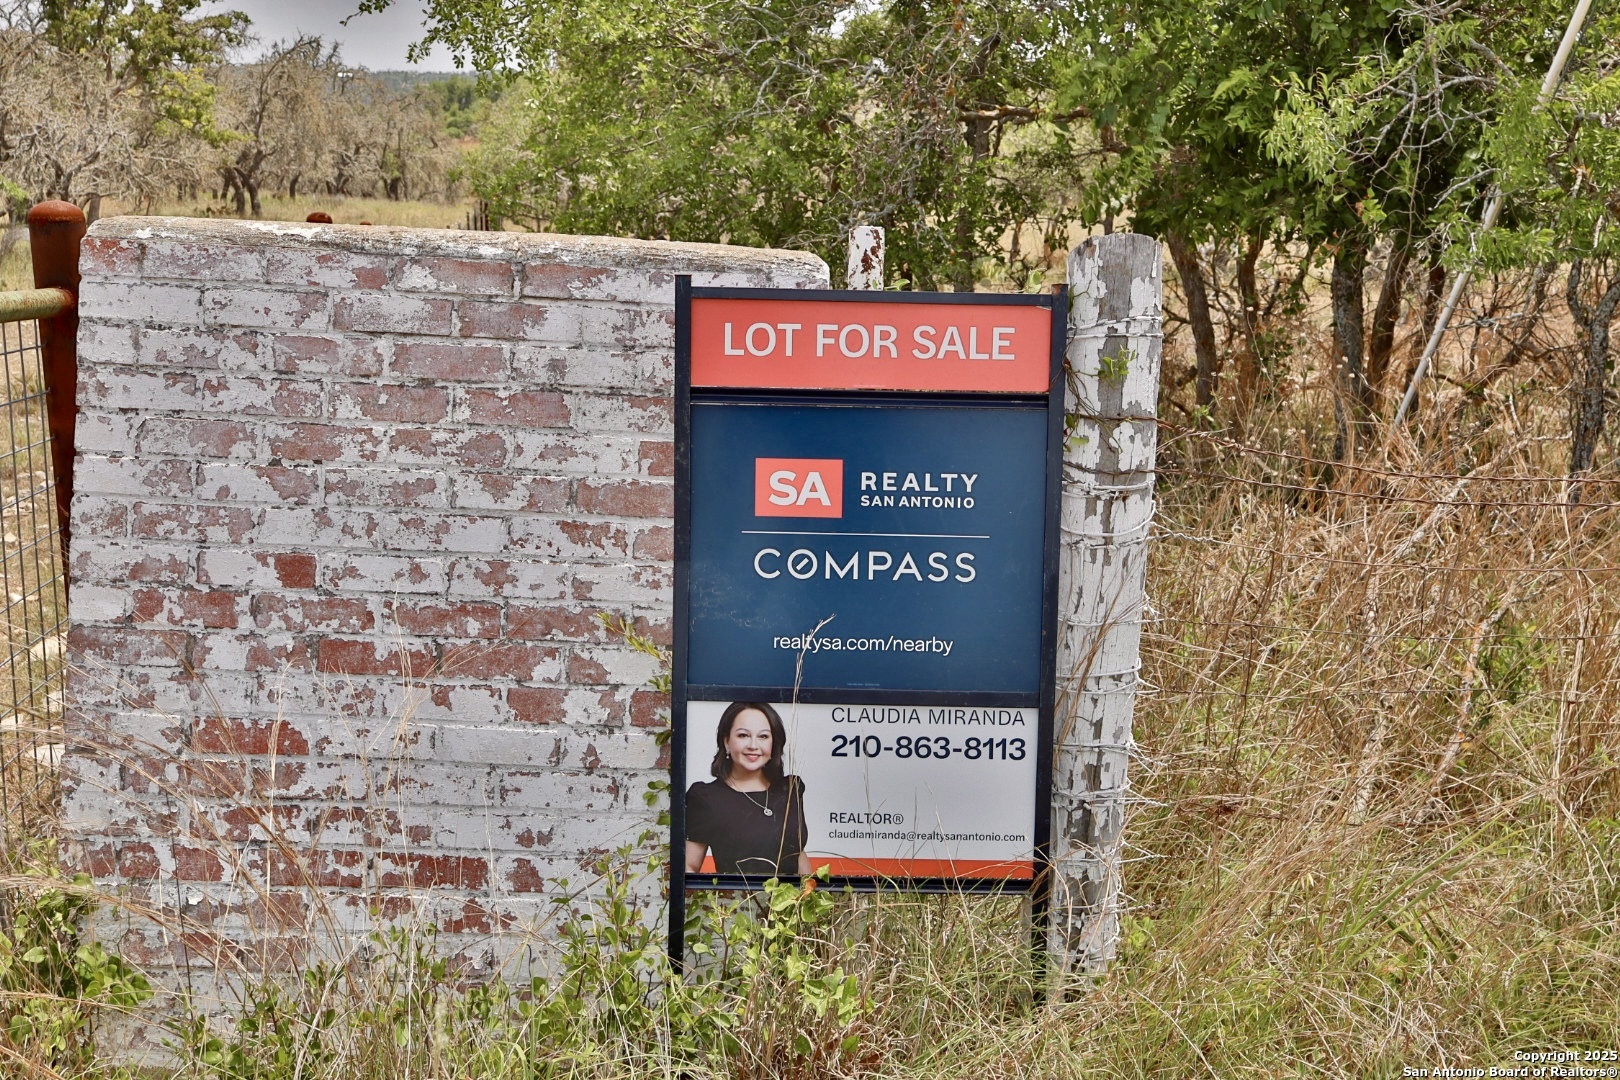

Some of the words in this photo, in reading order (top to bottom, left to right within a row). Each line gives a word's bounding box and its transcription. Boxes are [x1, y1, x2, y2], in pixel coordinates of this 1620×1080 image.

[723, 322, 802, 357] LOT
[816, 323, 898, 359] FOR
[911, 325, 1016, 361] SALE
[768, 469, 832, 507] SA
[860, 471, 979, 493] REALTY
[860, 495, 894, 508] SAN
[899, 496, 975, 510] ANTONIO
[753, 548, 977, 583] COMPASS
[773, 633, 954, 656] realtysa.com/nearby
[831, 707, 921, 725] CLAUDIA
[928, 709, 1026, 726] MIRANDA
[831, 734, 1027, 761] 210-863-8113
[829, 812, 904, 825] REALTOR®
[828, 829, 1026, 842] claudiamiranda@realtysanantonio.com
